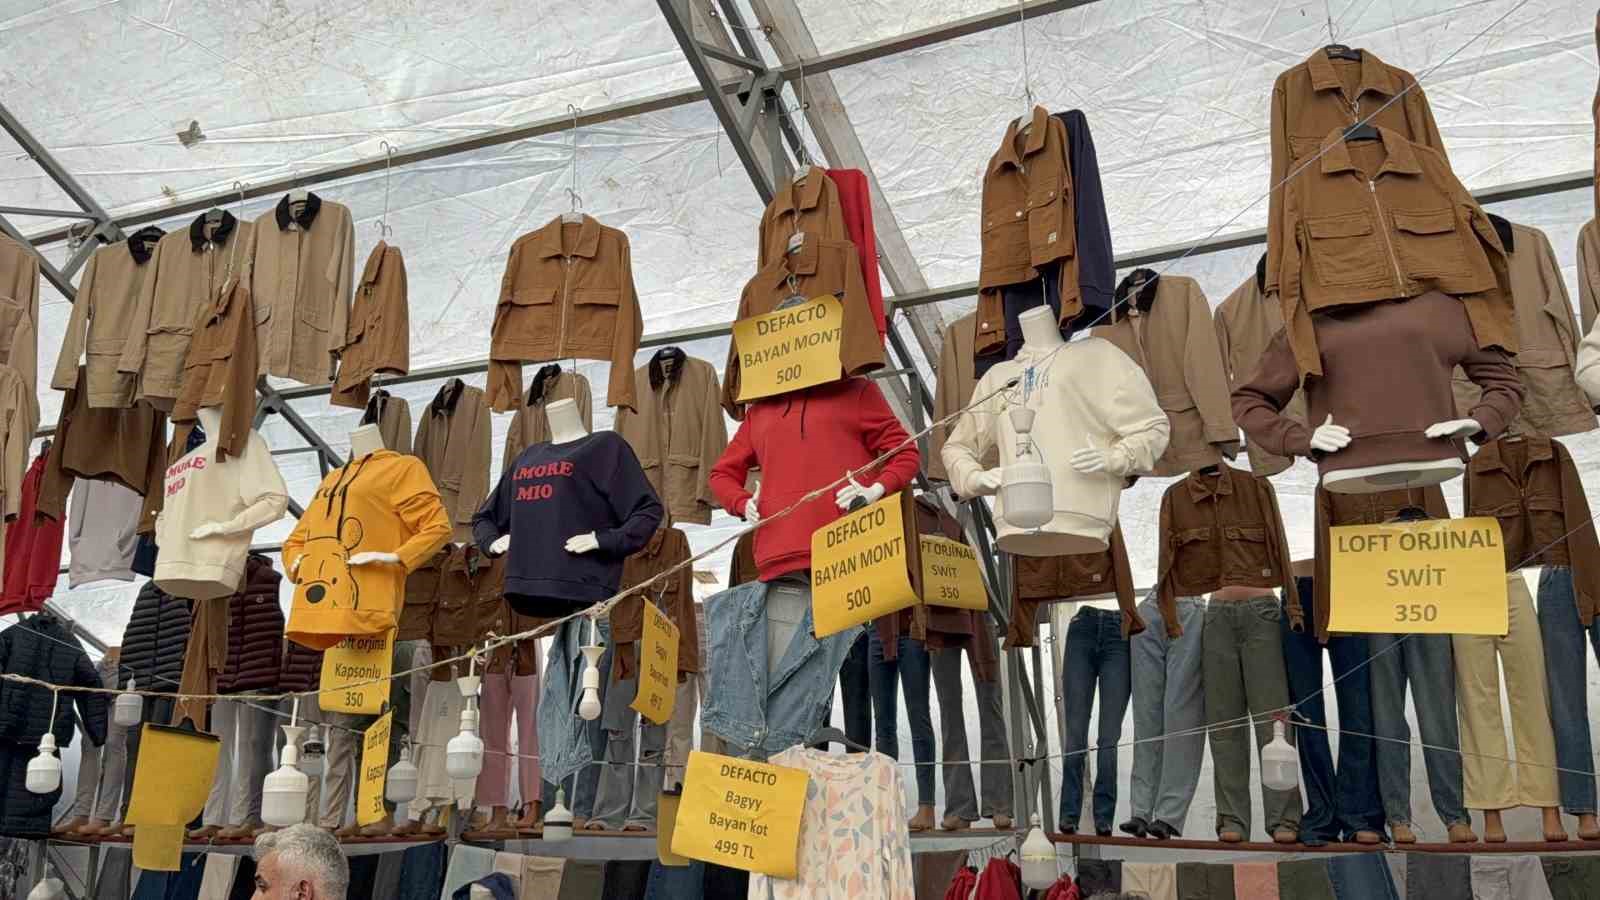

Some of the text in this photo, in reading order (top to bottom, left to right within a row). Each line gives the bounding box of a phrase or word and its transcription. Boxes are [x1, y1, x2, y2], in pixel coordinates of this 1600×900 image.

[756, 303, 826, 336] DEFACTO
[743, 327, 841, 368] BAYAN MONT
[776, 364, 802, 384] 500
[167, 456, 207, 477] MORE
[516, 483, 553, 501] MIO
[826, 507, 885, 548] DEFACTO
[921, 541, 931, 553] FT
[1338, 525, 1497, 553] LOFT ORJİNAL
[814, 537, 902, 587] BAYAN MONT
[1386, 564, 1446, 587] SWİT
[846, 586, 871, 610] 500
[940, 586, 960, 600] 350
[1395, 604, 1437, 622] 350
[344, 691, 364, 707] 350
[720, 764, 777, 786] DEFACTO
[725, 790, 763, 812] Bagyy
[709, 812, 768, 836] Bayan kot
[714, 839, 755, 860] 499 TL
